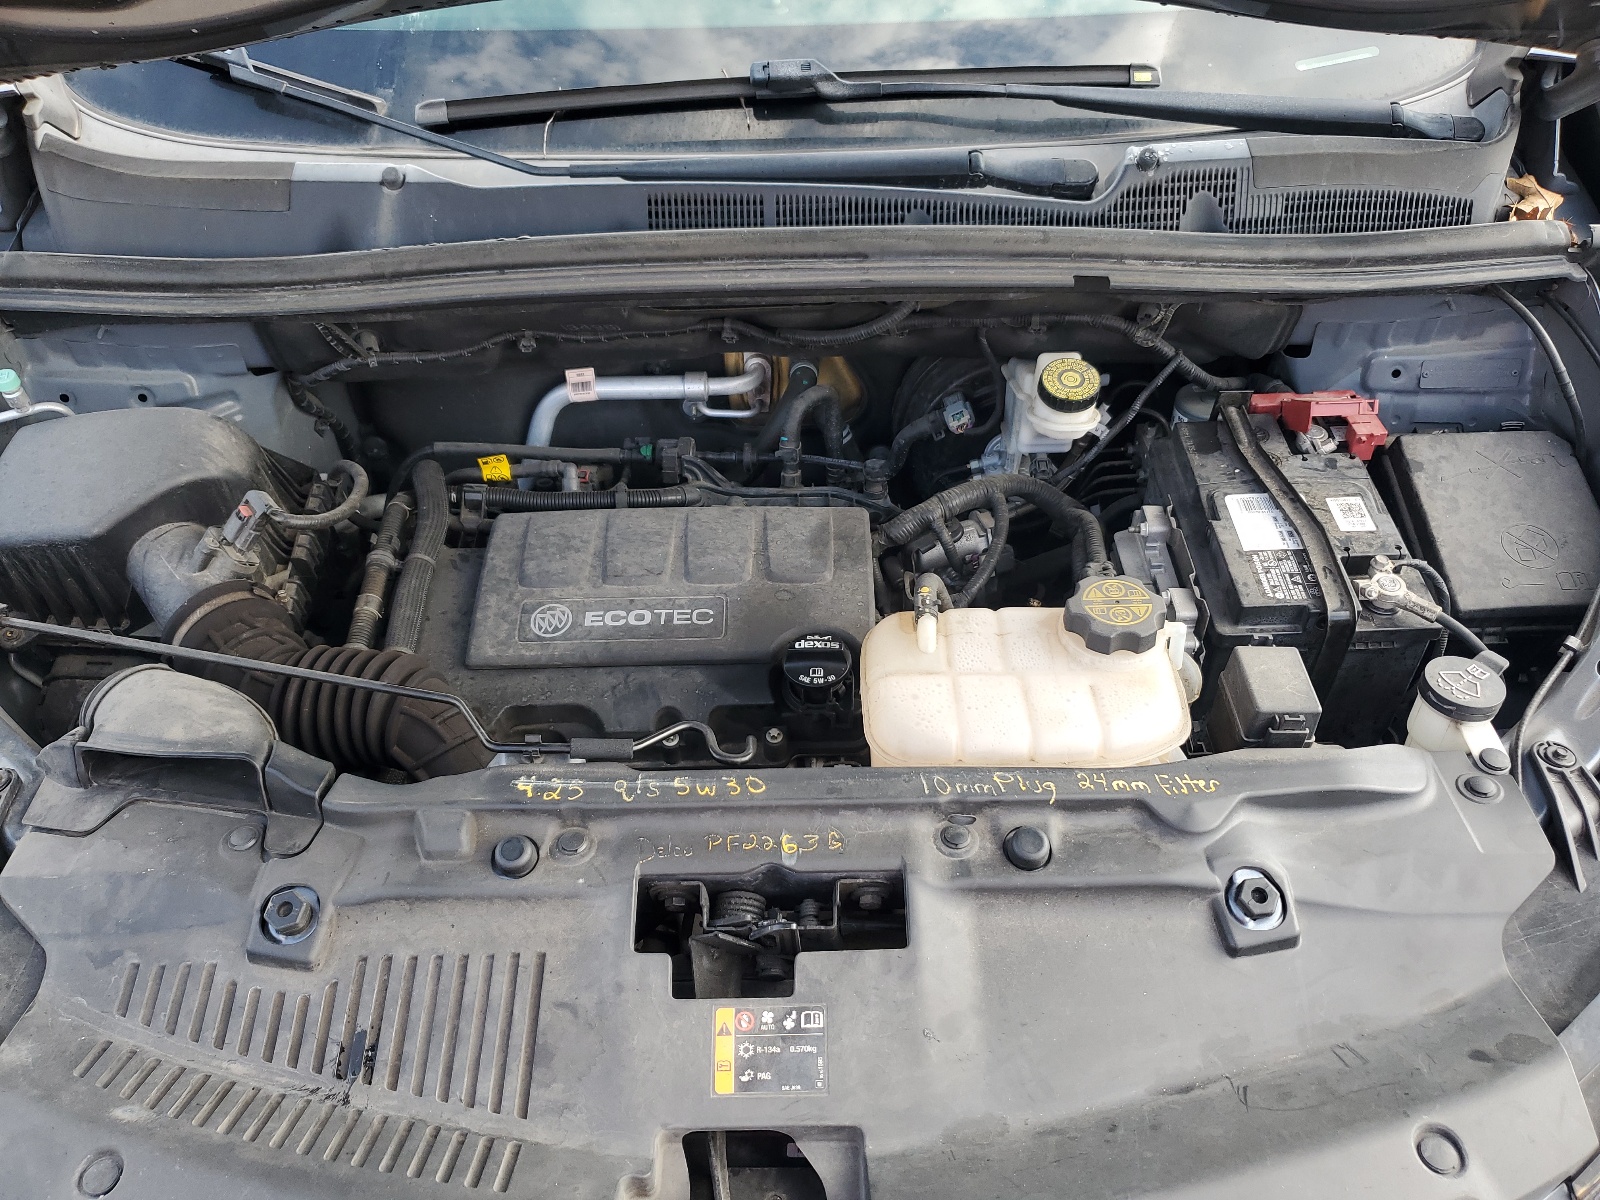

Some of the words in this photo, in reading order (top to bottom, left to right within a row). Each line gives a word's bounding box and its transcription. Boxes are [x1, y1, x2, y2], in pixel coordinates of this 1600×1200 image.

[584, 608, 714, 626] ECOTEC
[794, 640, 840, 649] dexos
[798, 674, 812, 684] SAE
[813, 674, 836, 684] 5W-30
[1154, 773, 1220, 795] Filter
[756, 1046, 781, 1054] R-134a
[789, 1045, 817, 1054] 0.570kg
[757, 1071, 772, 1080] PAG
